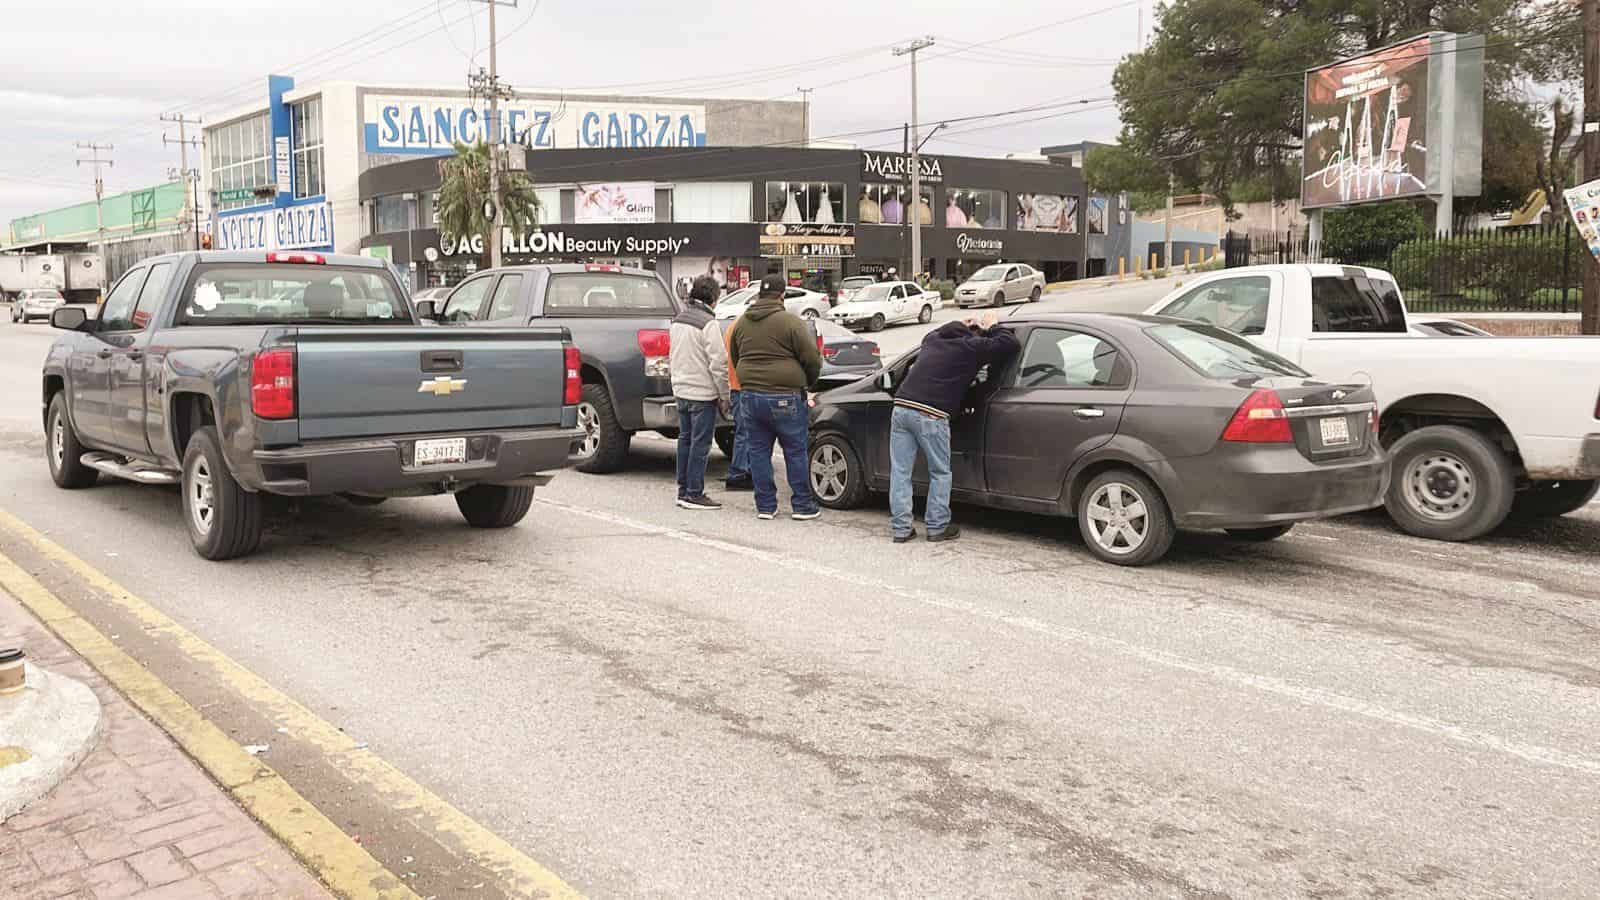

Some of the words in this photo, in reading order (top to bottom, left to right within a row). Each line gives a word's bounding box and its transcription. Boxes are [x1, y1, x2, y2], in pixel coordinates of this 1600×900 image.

[383, 105, 552, 147] SANCHEZ
[582, 111, 695, 149] GARZA
[276, 206, 328, 246] GARZA
[566, 237, 621, 255] Beauty
[626, 236, 683, 255] Supply
[811, 244, 841, 256] PLATA
[860, 265, 884, 273] RENTA
